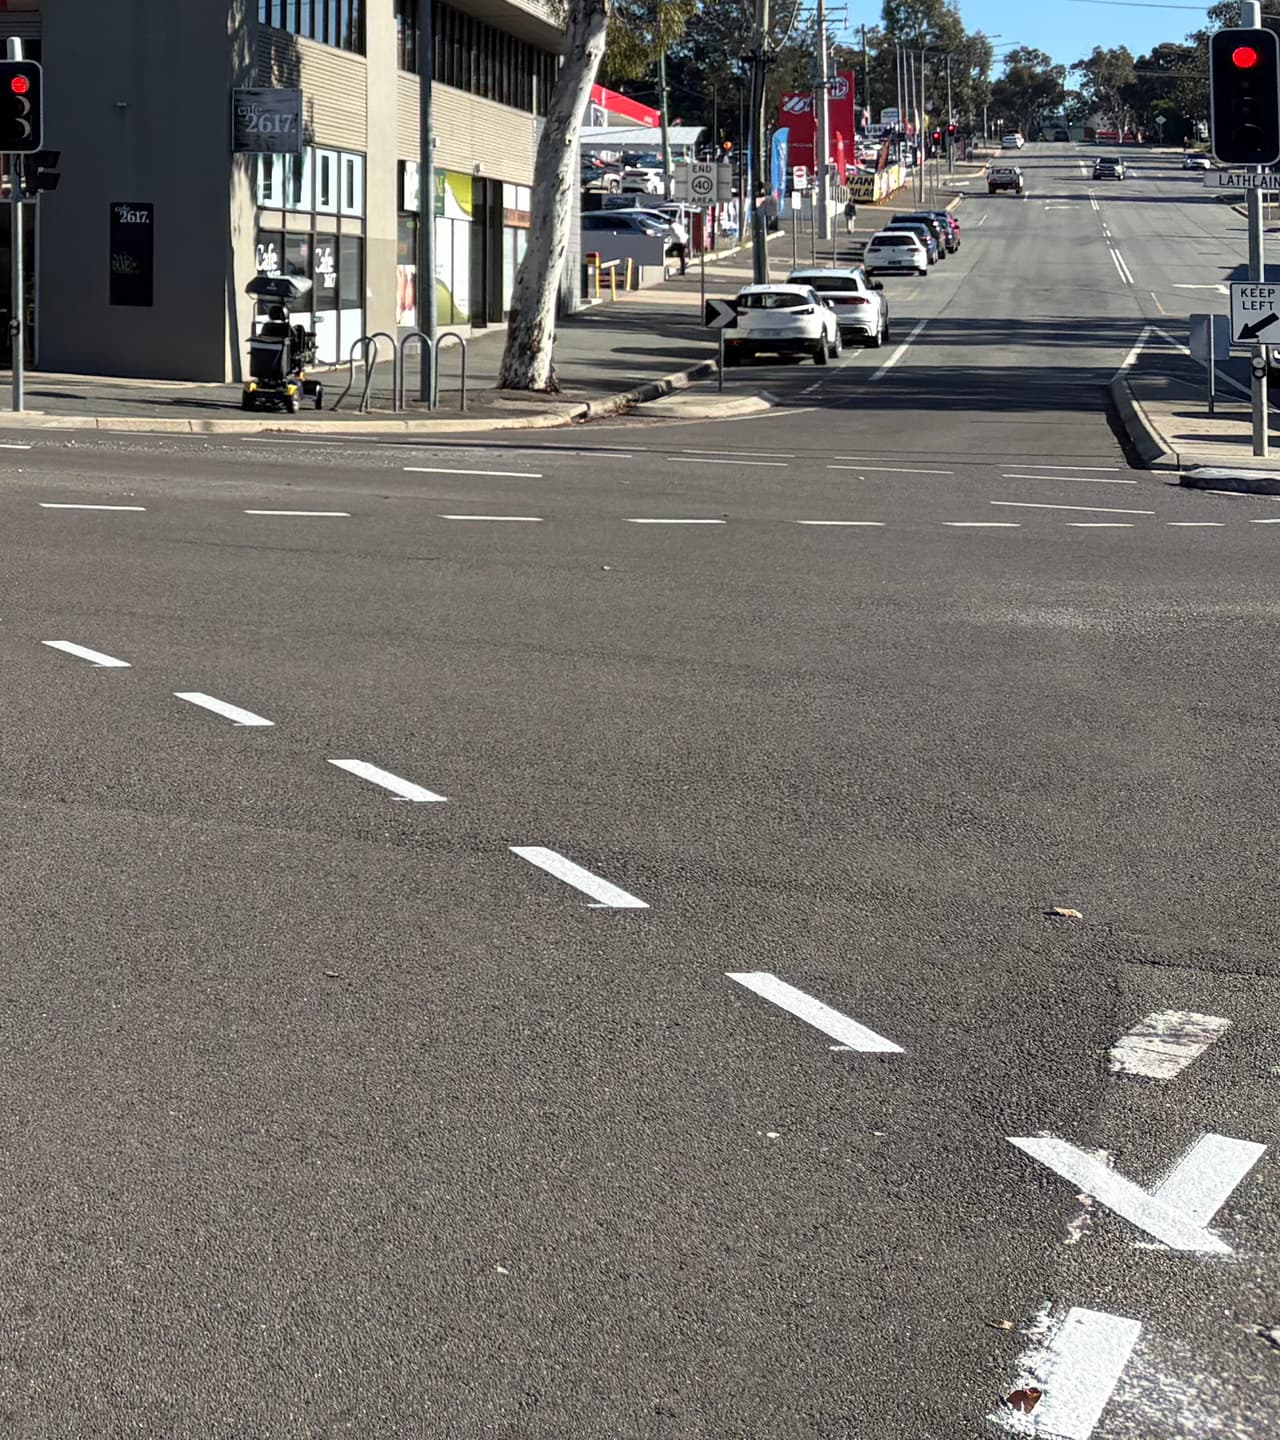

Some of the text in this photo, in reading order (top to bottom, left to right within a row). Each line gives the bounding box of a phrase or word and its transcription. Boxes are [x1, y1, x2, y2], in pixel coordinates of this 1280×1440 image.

[237, 103, 263, 116] cafe
[245, 114, 297, 133] 2617.
[692, 164, 712, 174] END
[695, 180, 710, 191] 40
[119, 210, 149, 224] 2617.
[256, 243, 278, 271] Cafe
[315, 248, 335, 275] Cafe
[1240, 287, 1276, 298] KEEP
[1242, 300, 1275, 311] LEFT
